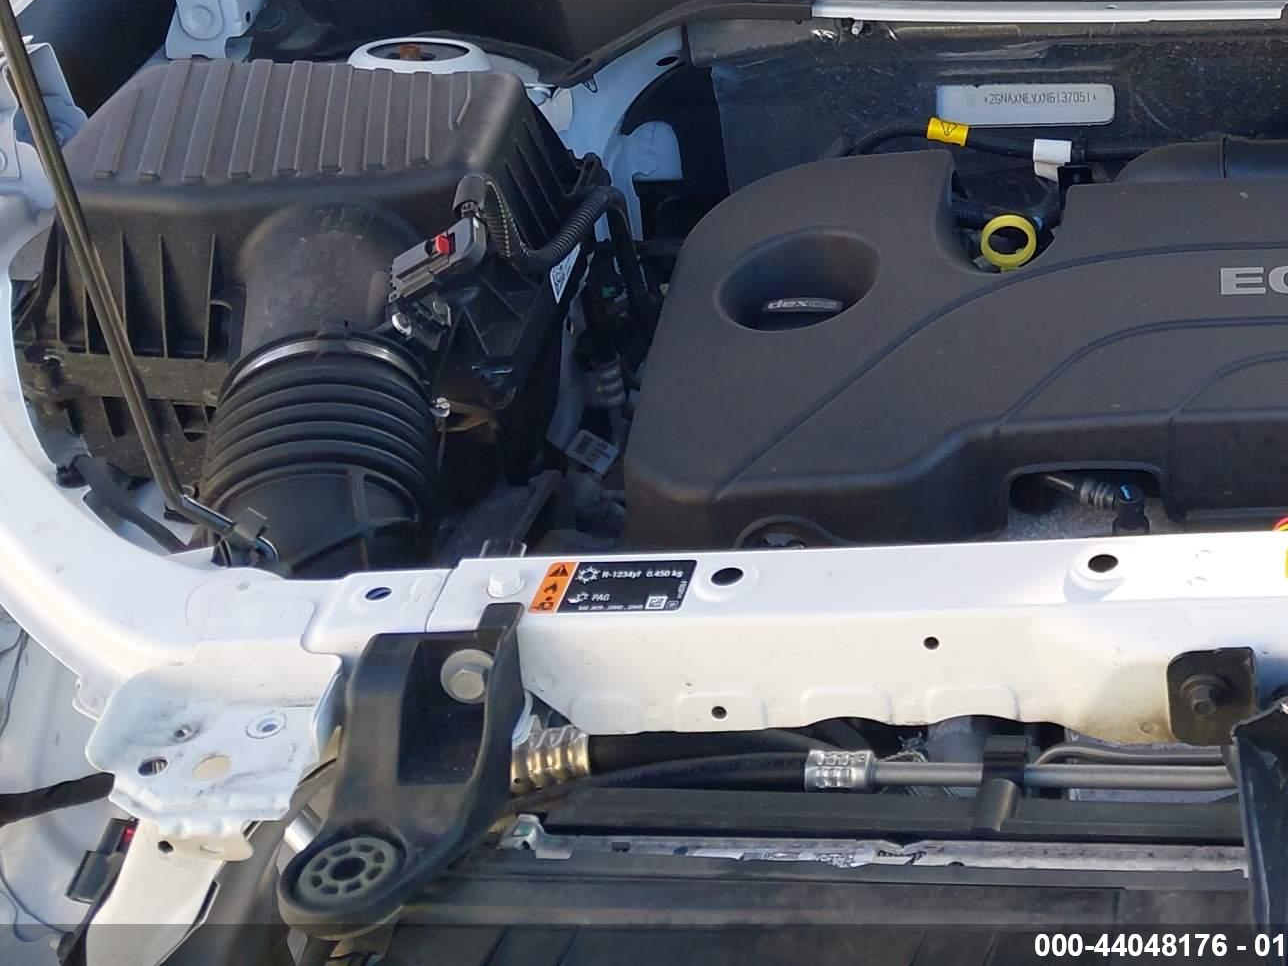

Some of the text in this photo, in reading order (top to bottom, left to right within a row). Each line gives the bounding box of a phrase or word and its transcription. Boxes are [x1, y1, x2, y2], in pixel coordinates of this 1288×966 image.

[601, 569, 684, 579] R-1234yf 0.450 kg
[591, 593, 611, 602] PAG
